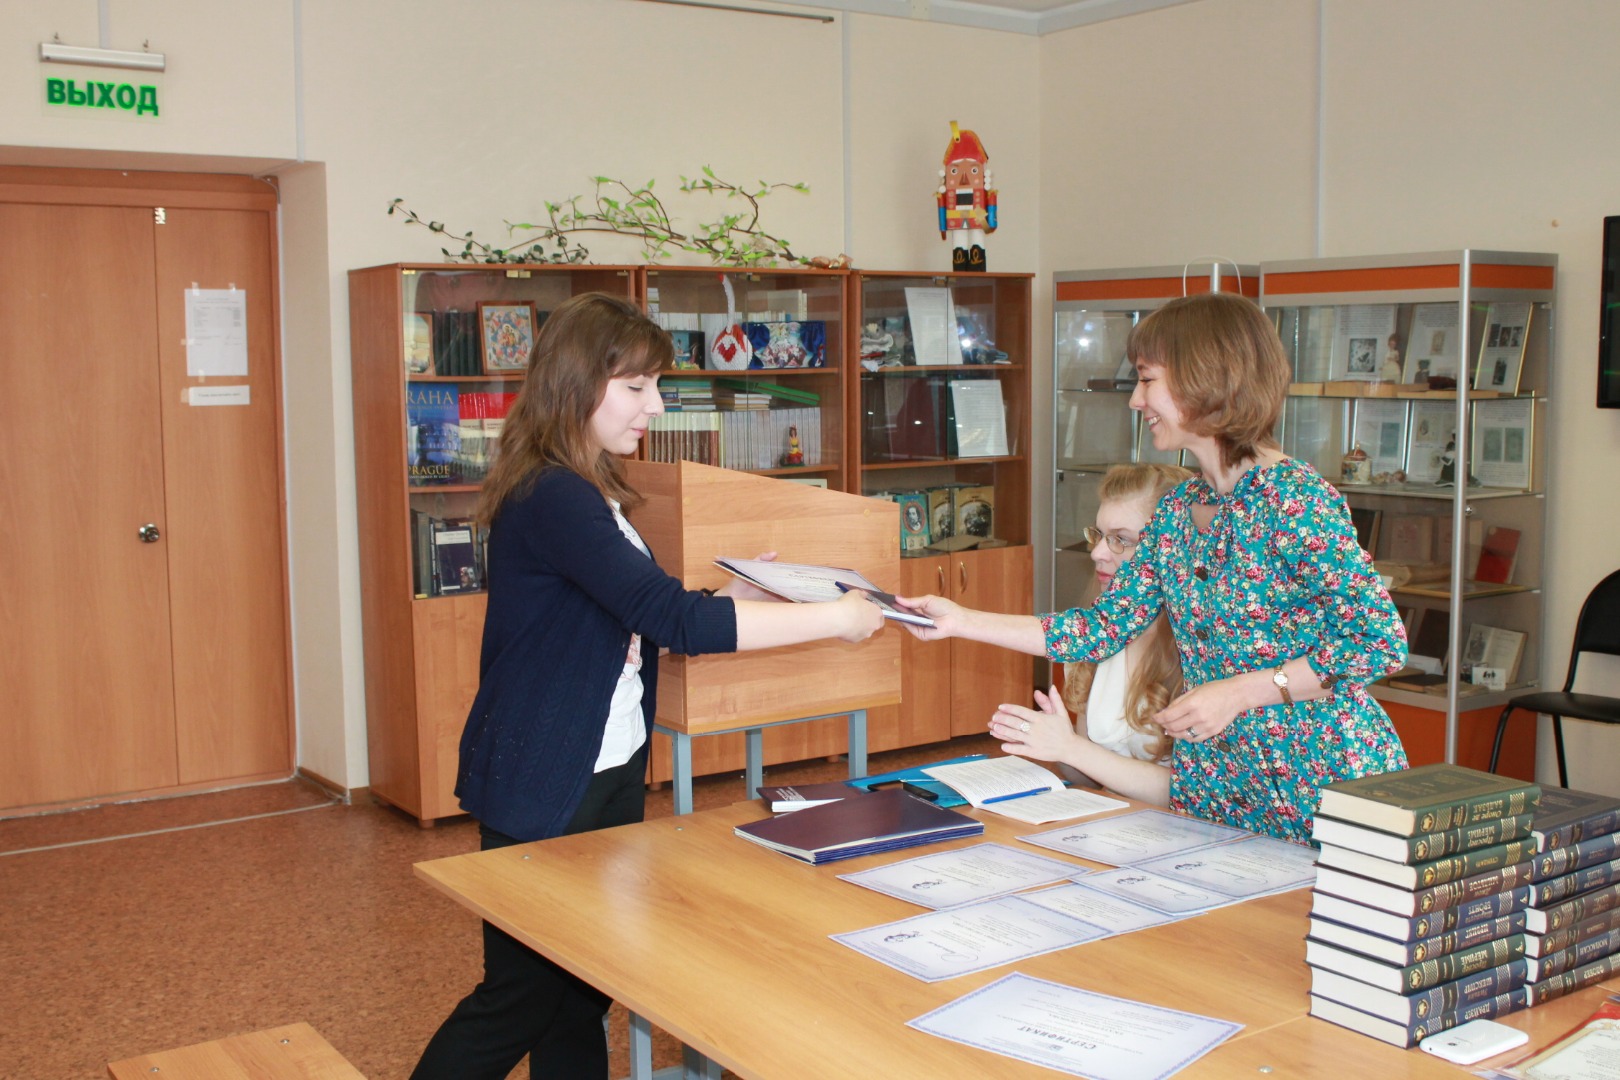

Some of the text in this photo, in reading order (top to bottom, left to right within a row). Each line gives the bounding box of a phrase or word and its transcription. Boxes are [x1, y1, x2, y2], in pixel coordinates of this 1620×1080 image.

[46, 77, 159, 117] ВЫХОД
[407, 390, 454, 404] RAHA
[1460, 949, 1488, 965] МЕРИМЕ
[1463, 976, 1492, 994] ШЕКСПИР
[1464, 1002, 1490, 1020] ДРАЙЗЕР
